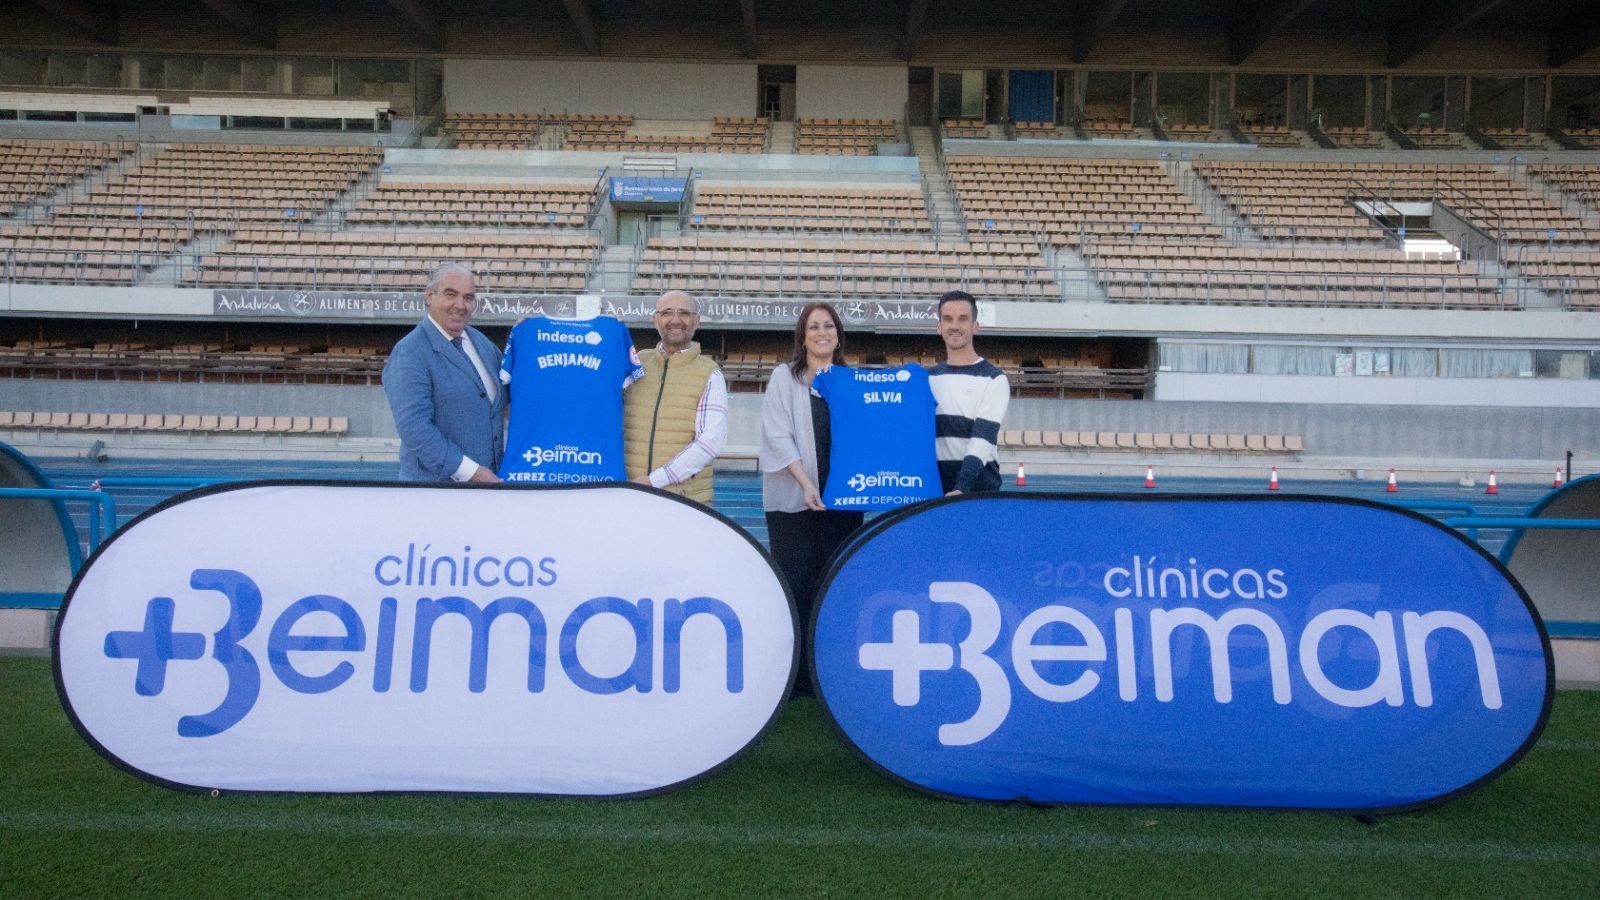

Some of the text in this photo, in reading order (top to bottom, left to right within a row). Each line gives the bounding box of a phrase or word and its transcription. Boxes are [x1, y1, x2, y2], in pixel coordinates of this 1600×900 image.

[218, 295, 426, 312] Andalucía ALIMENTOS DE CALI
[482, 297, 545, 315] Andalucía
[708, 303, 770, 317] ALIMENTOS
[774, 305, 788, 317] DE
[874, 303, 939, 320] Andalucía
[537, 330, 583, 343] indeso
[537, 353, 601, 370] BENJAMÍN
[855, 371, 895, 382] indeso
[864, 392, 902, 403] SILVIA
[508, 472, 546, 481] XEREZ
[834, 496, 869, 506] XEREZ
[374, 543, 557, 587] clínicas
[1102, 555, 1289, 600] clínicas
